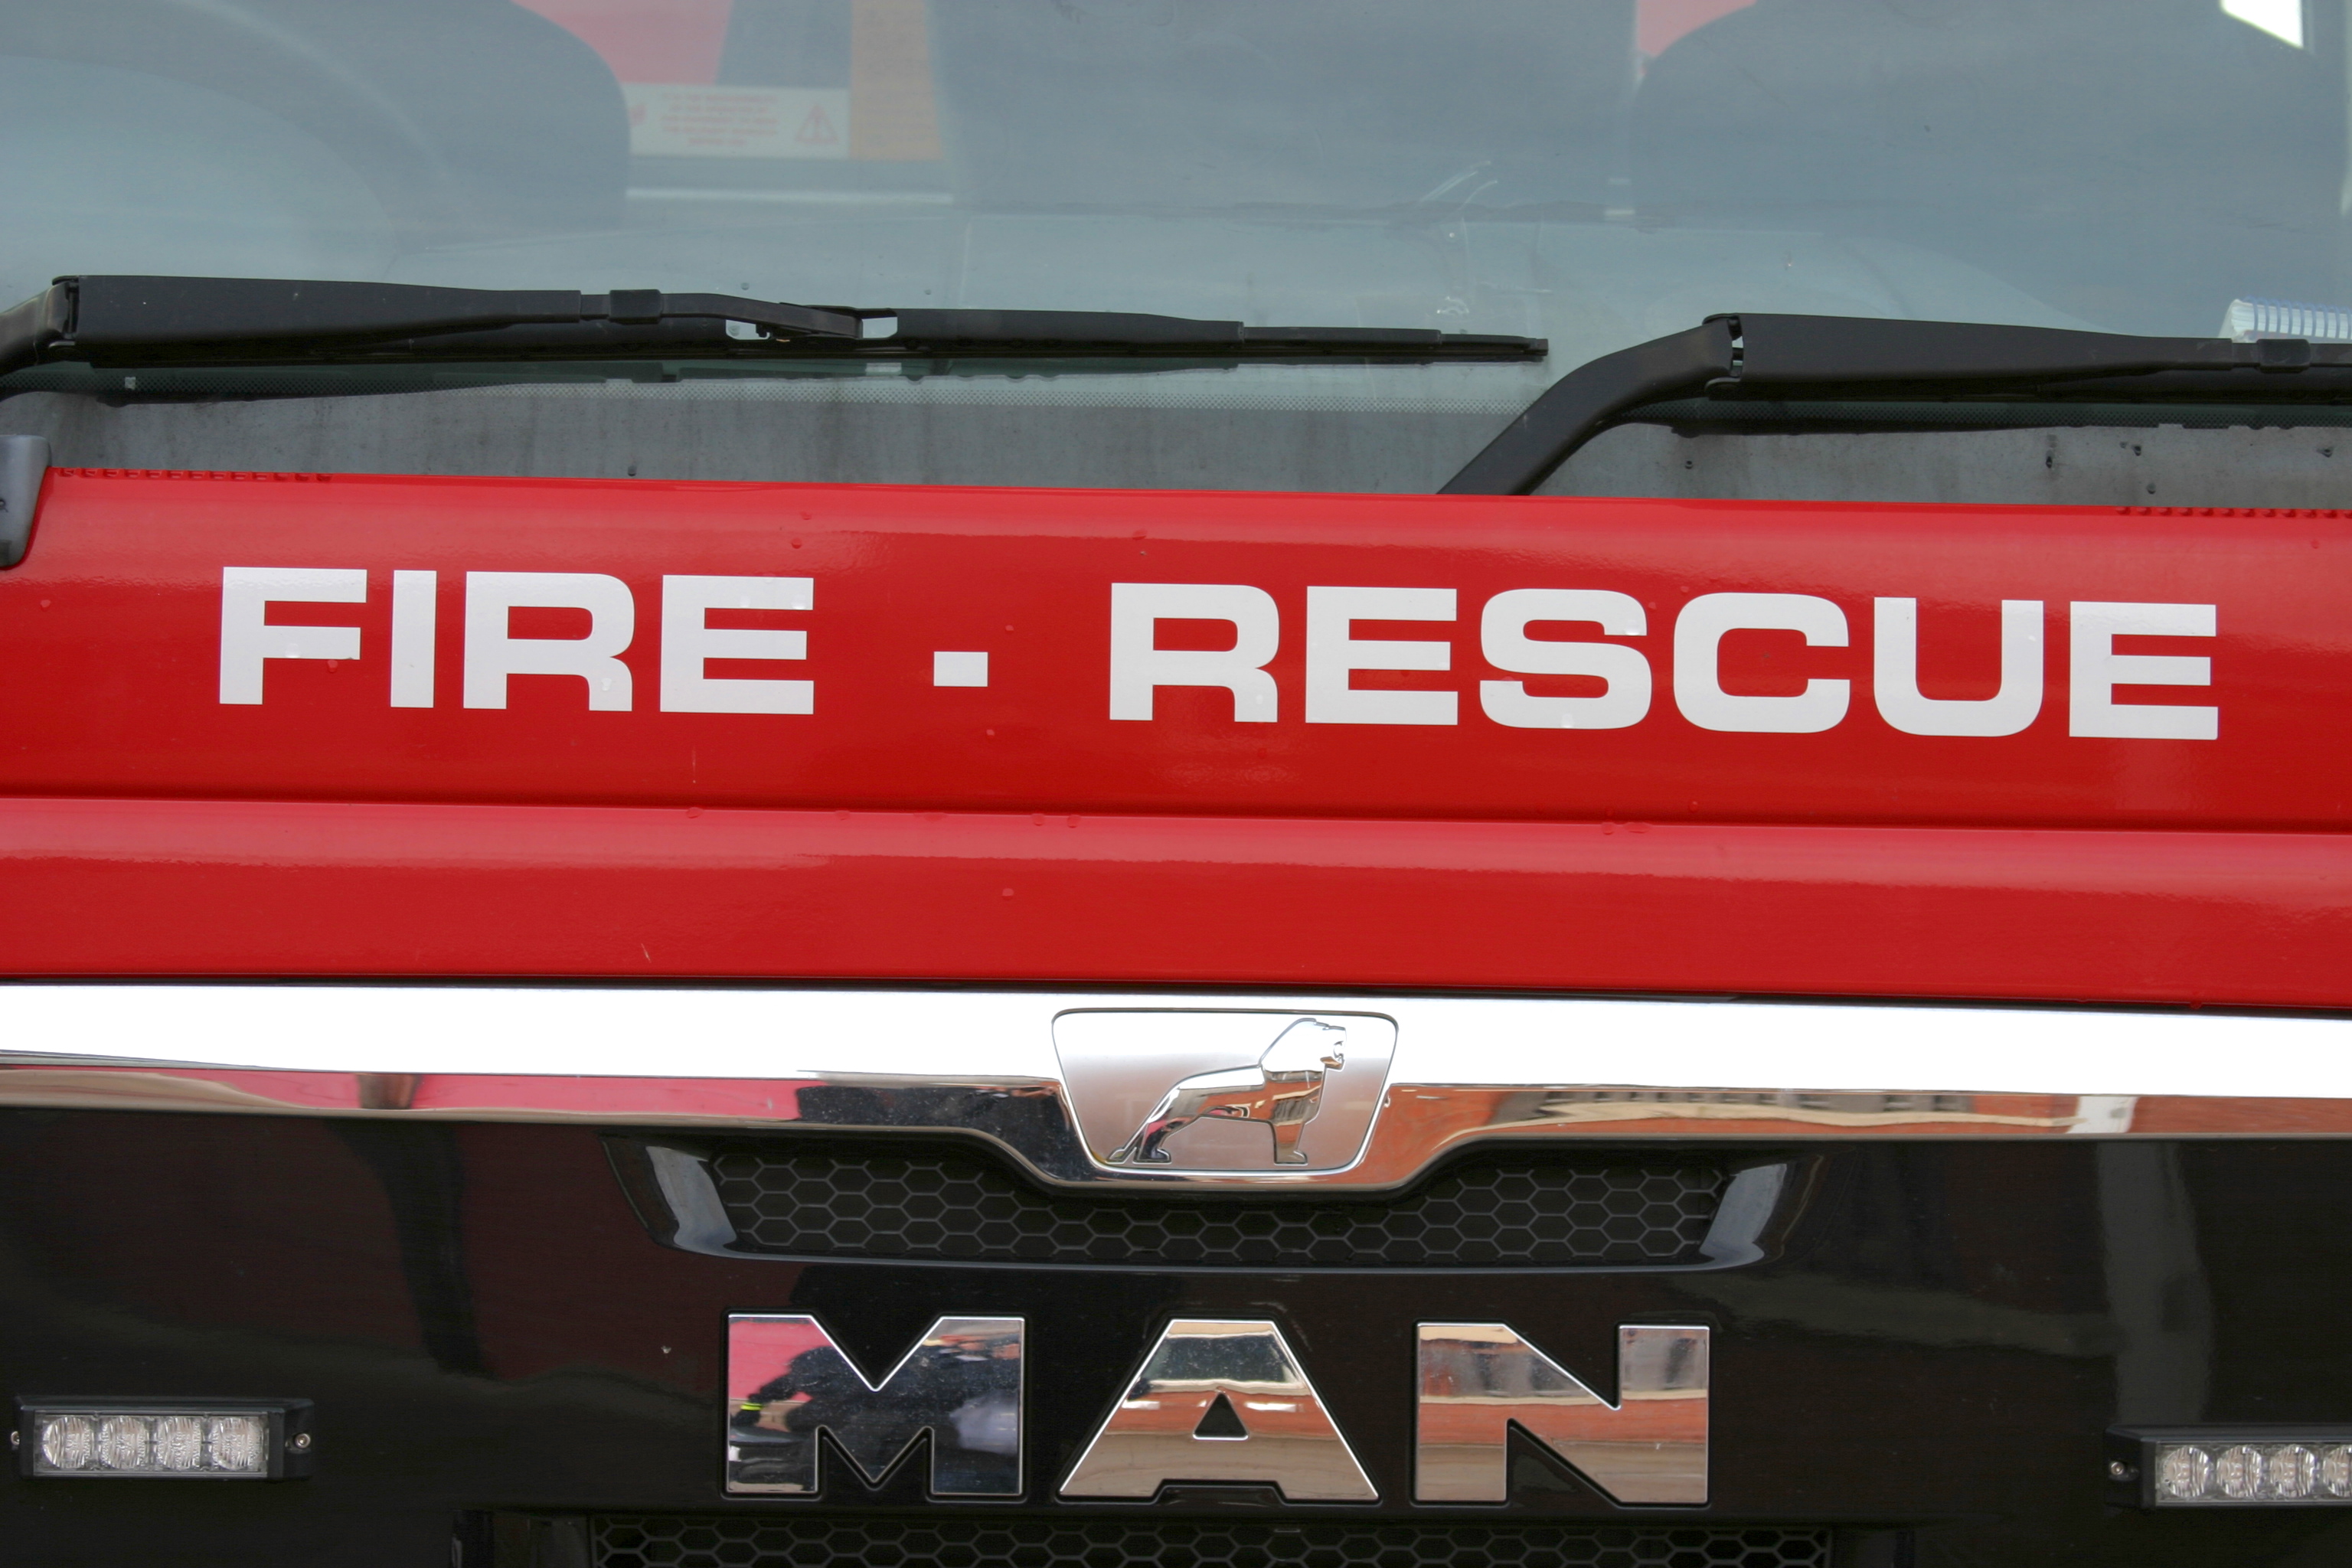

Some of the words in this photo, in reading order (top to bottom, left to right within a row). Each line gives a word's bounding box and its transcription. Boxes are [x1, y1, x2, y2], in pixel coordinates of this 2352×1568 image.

[219, 567, 815, 715] FIRE
[1109, 582, 2219, 740] RESCUE
[726, 1314, 1710, 1504] MAN
